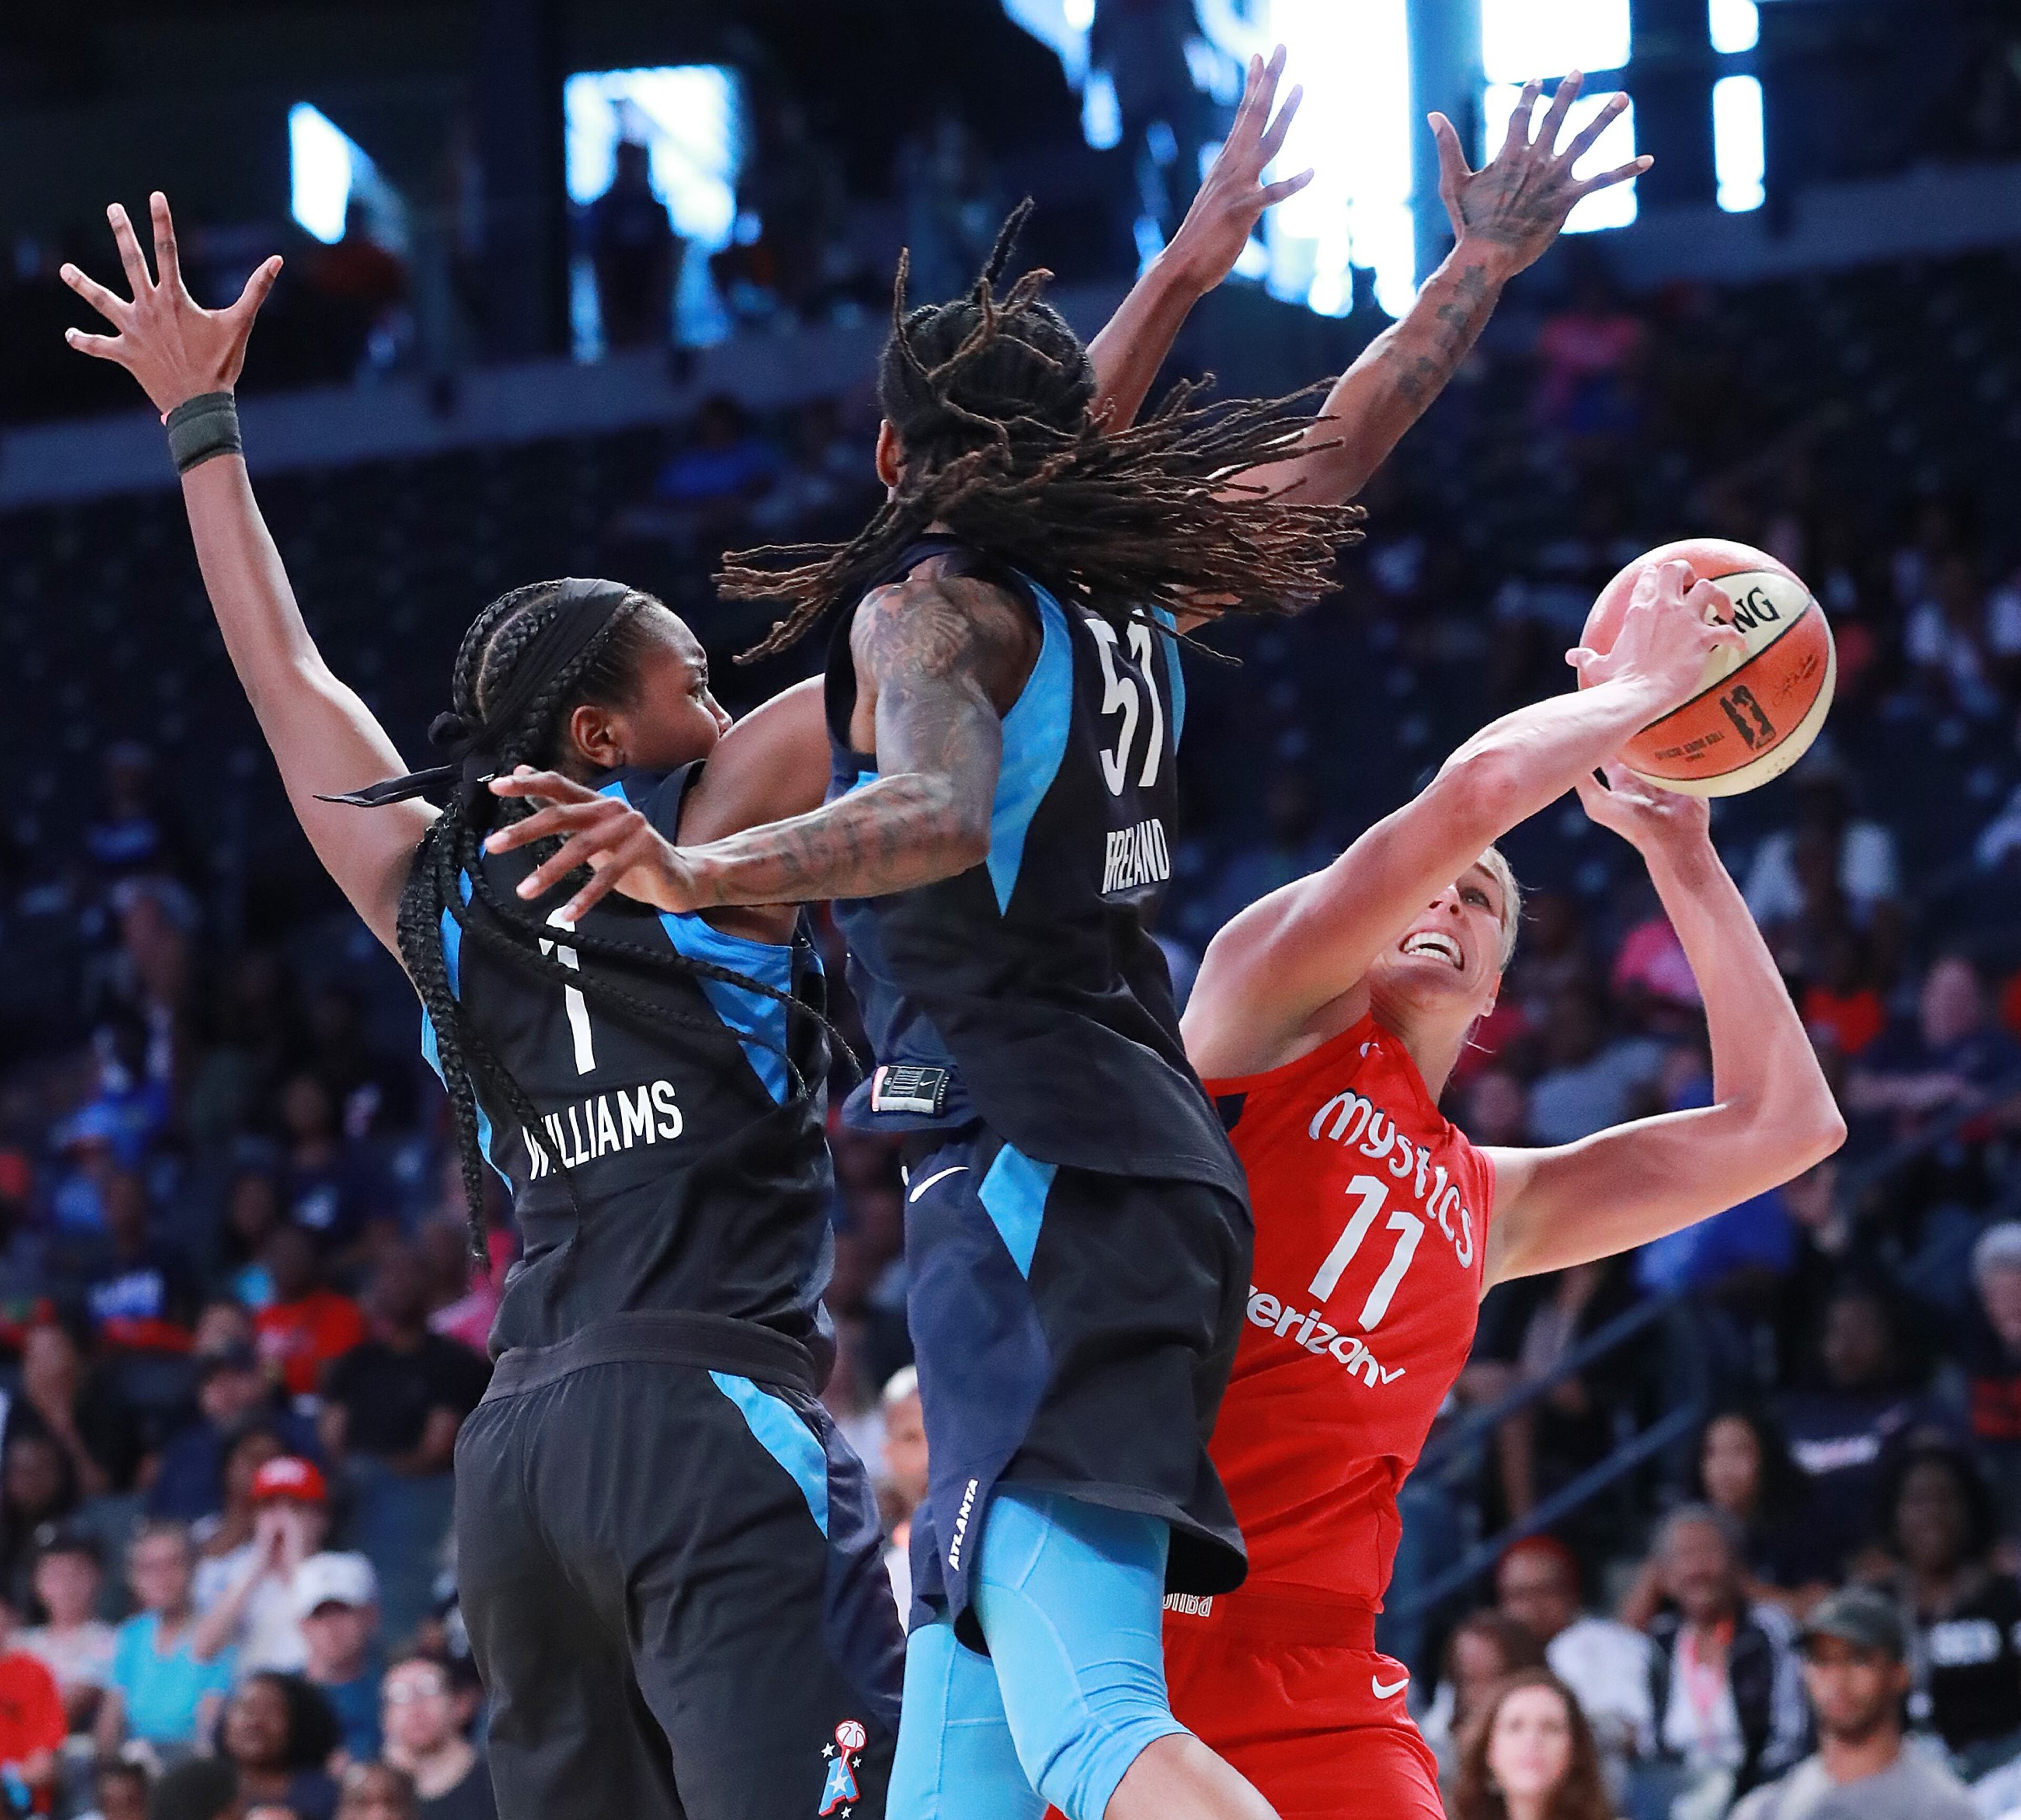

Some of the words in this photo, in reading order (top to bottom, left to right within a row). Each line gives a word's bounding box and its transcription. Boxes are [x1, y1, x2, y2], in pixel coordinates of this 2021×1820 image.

[1084, 609, 1164, 796] 51
[538, 905, 596, 1075] 1
[521, 1079, 683, 1181] WILLIAMS
[1307, 1175, 1425, 1333] 11
[1246, 1284, 1380, 1389] erizon
[948, 1479, 979, 1572] ATLANTA
